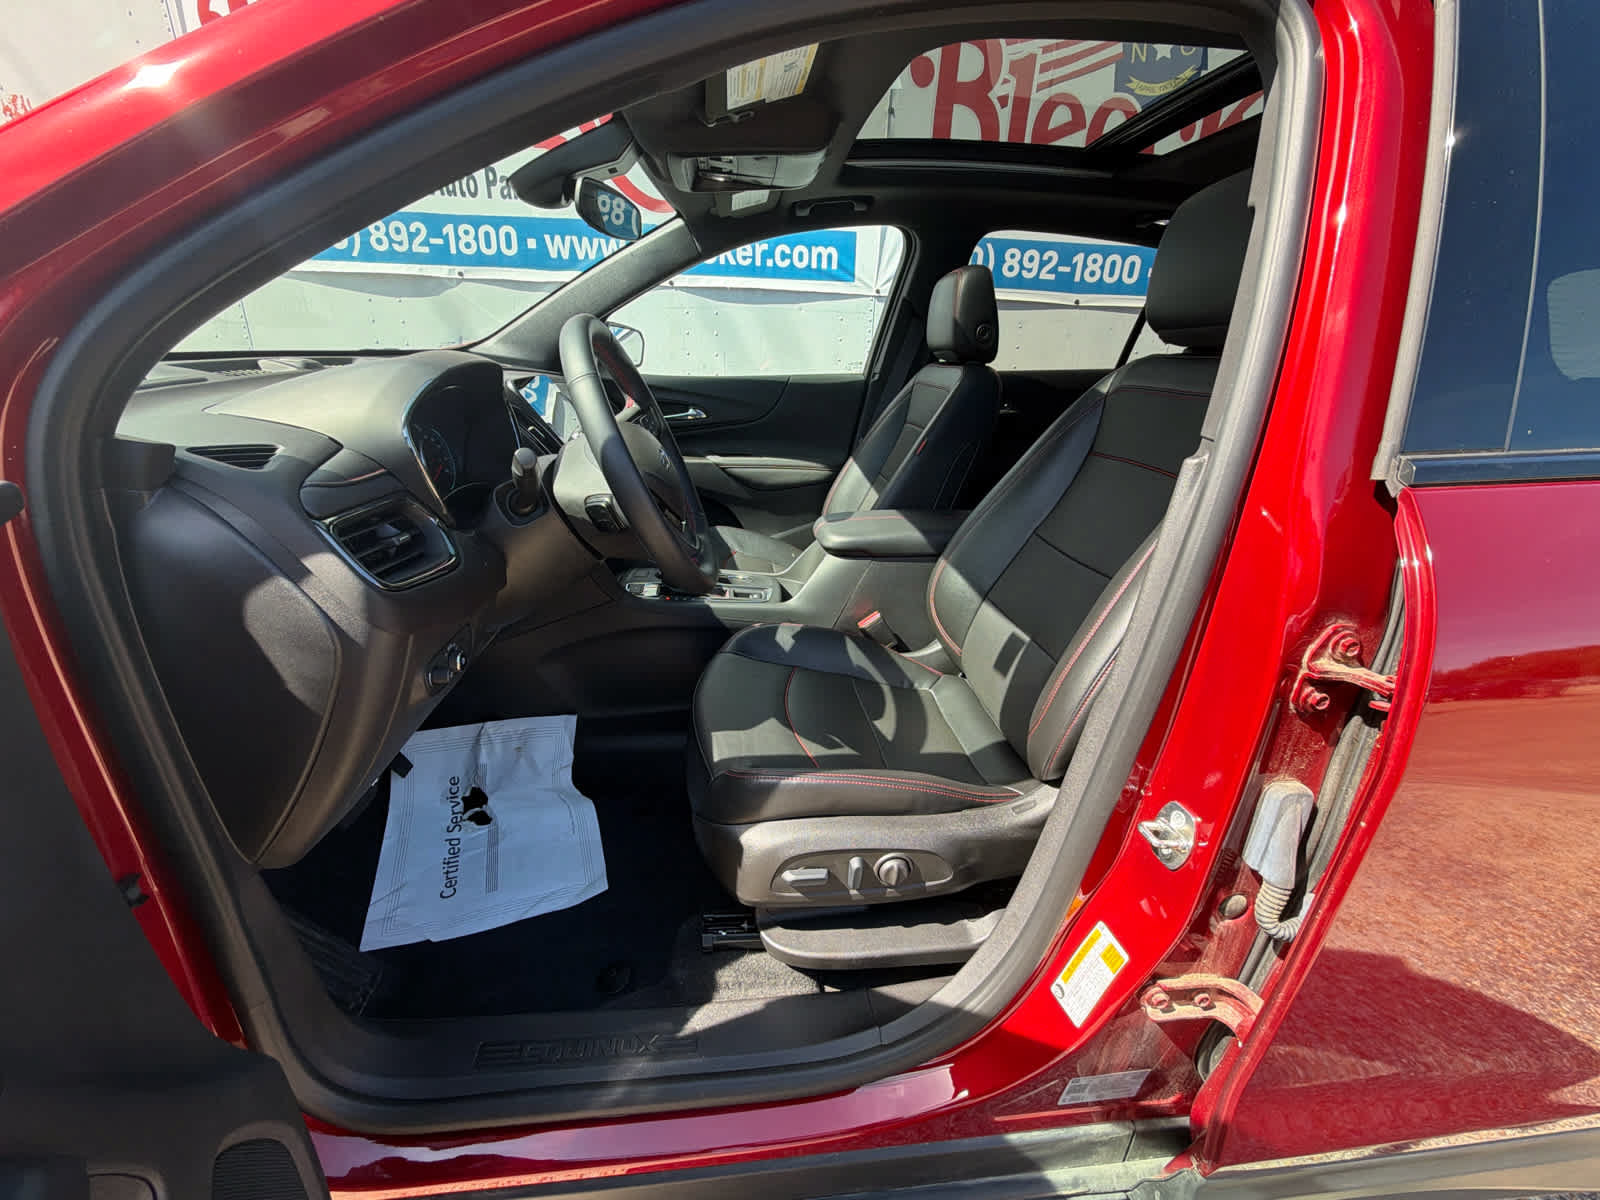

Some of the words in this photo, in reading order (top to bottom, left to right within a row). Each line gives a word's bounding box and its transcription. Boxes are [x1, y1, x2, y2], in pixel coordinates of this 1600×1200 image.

[367, 220, 518, 257] 892-1800
[1001, 248, 1142, 285] 892-1800
[446, 776, 463, 833] Service
[439, 838, 461, 899] Certified
